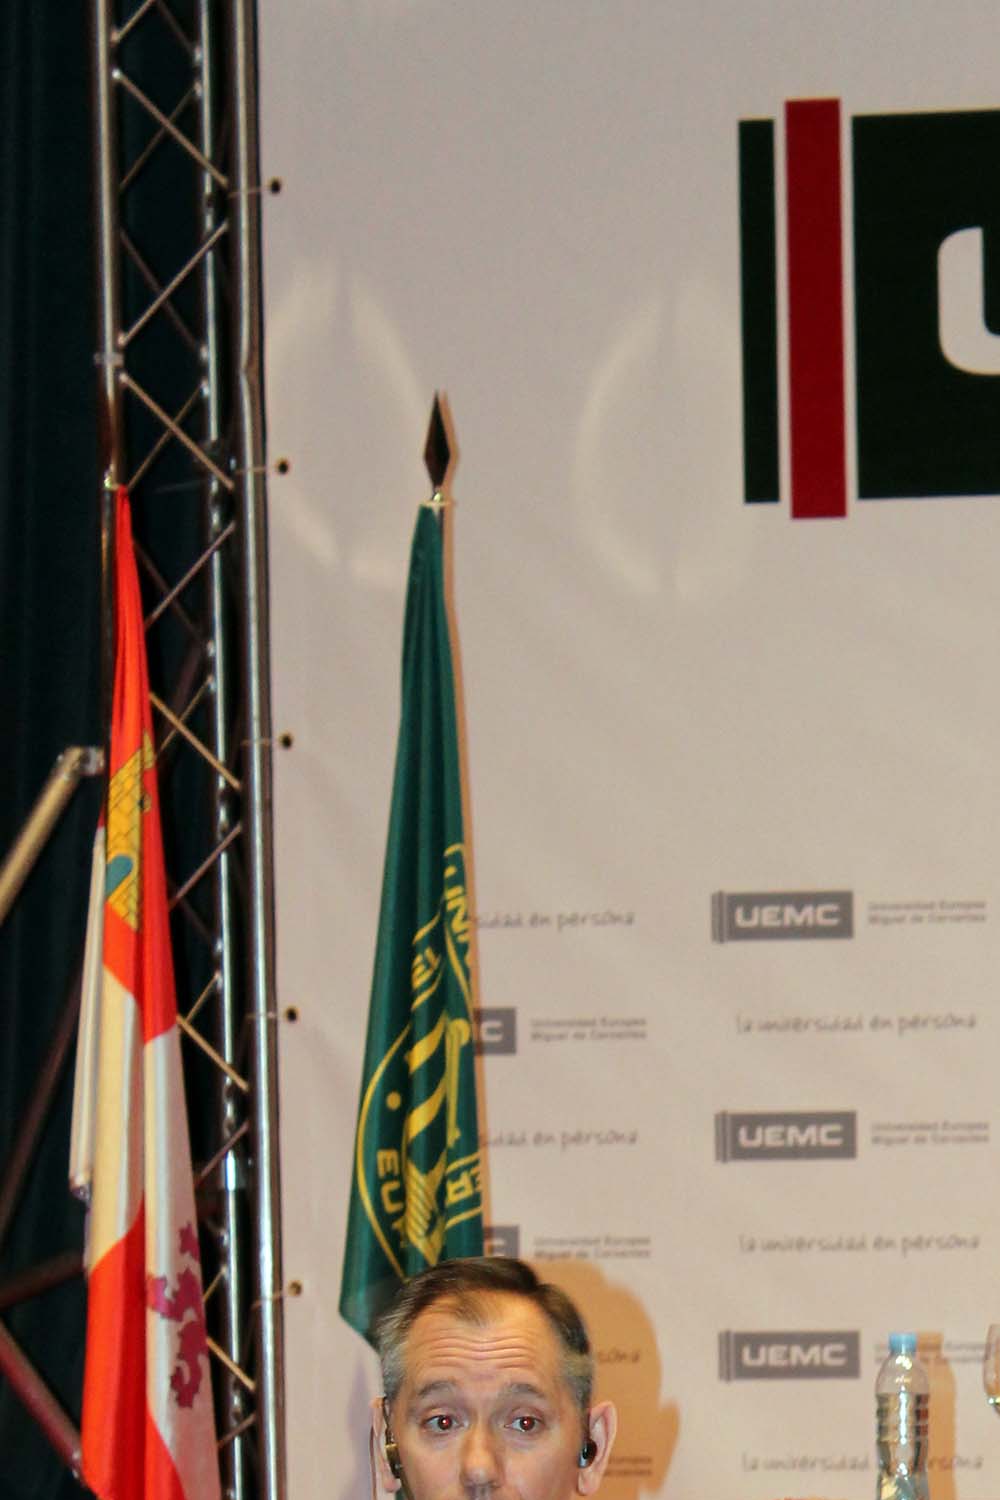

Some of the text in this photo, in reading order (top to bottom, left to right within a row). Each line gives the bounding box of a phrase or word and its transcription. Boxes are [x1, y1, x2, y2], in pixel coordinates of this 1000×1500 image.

[735, 903, 840, 927] UEMC
[738, 1124, 843, 1148] UEMC
[741, 1342, 846, 1366] UEMC
